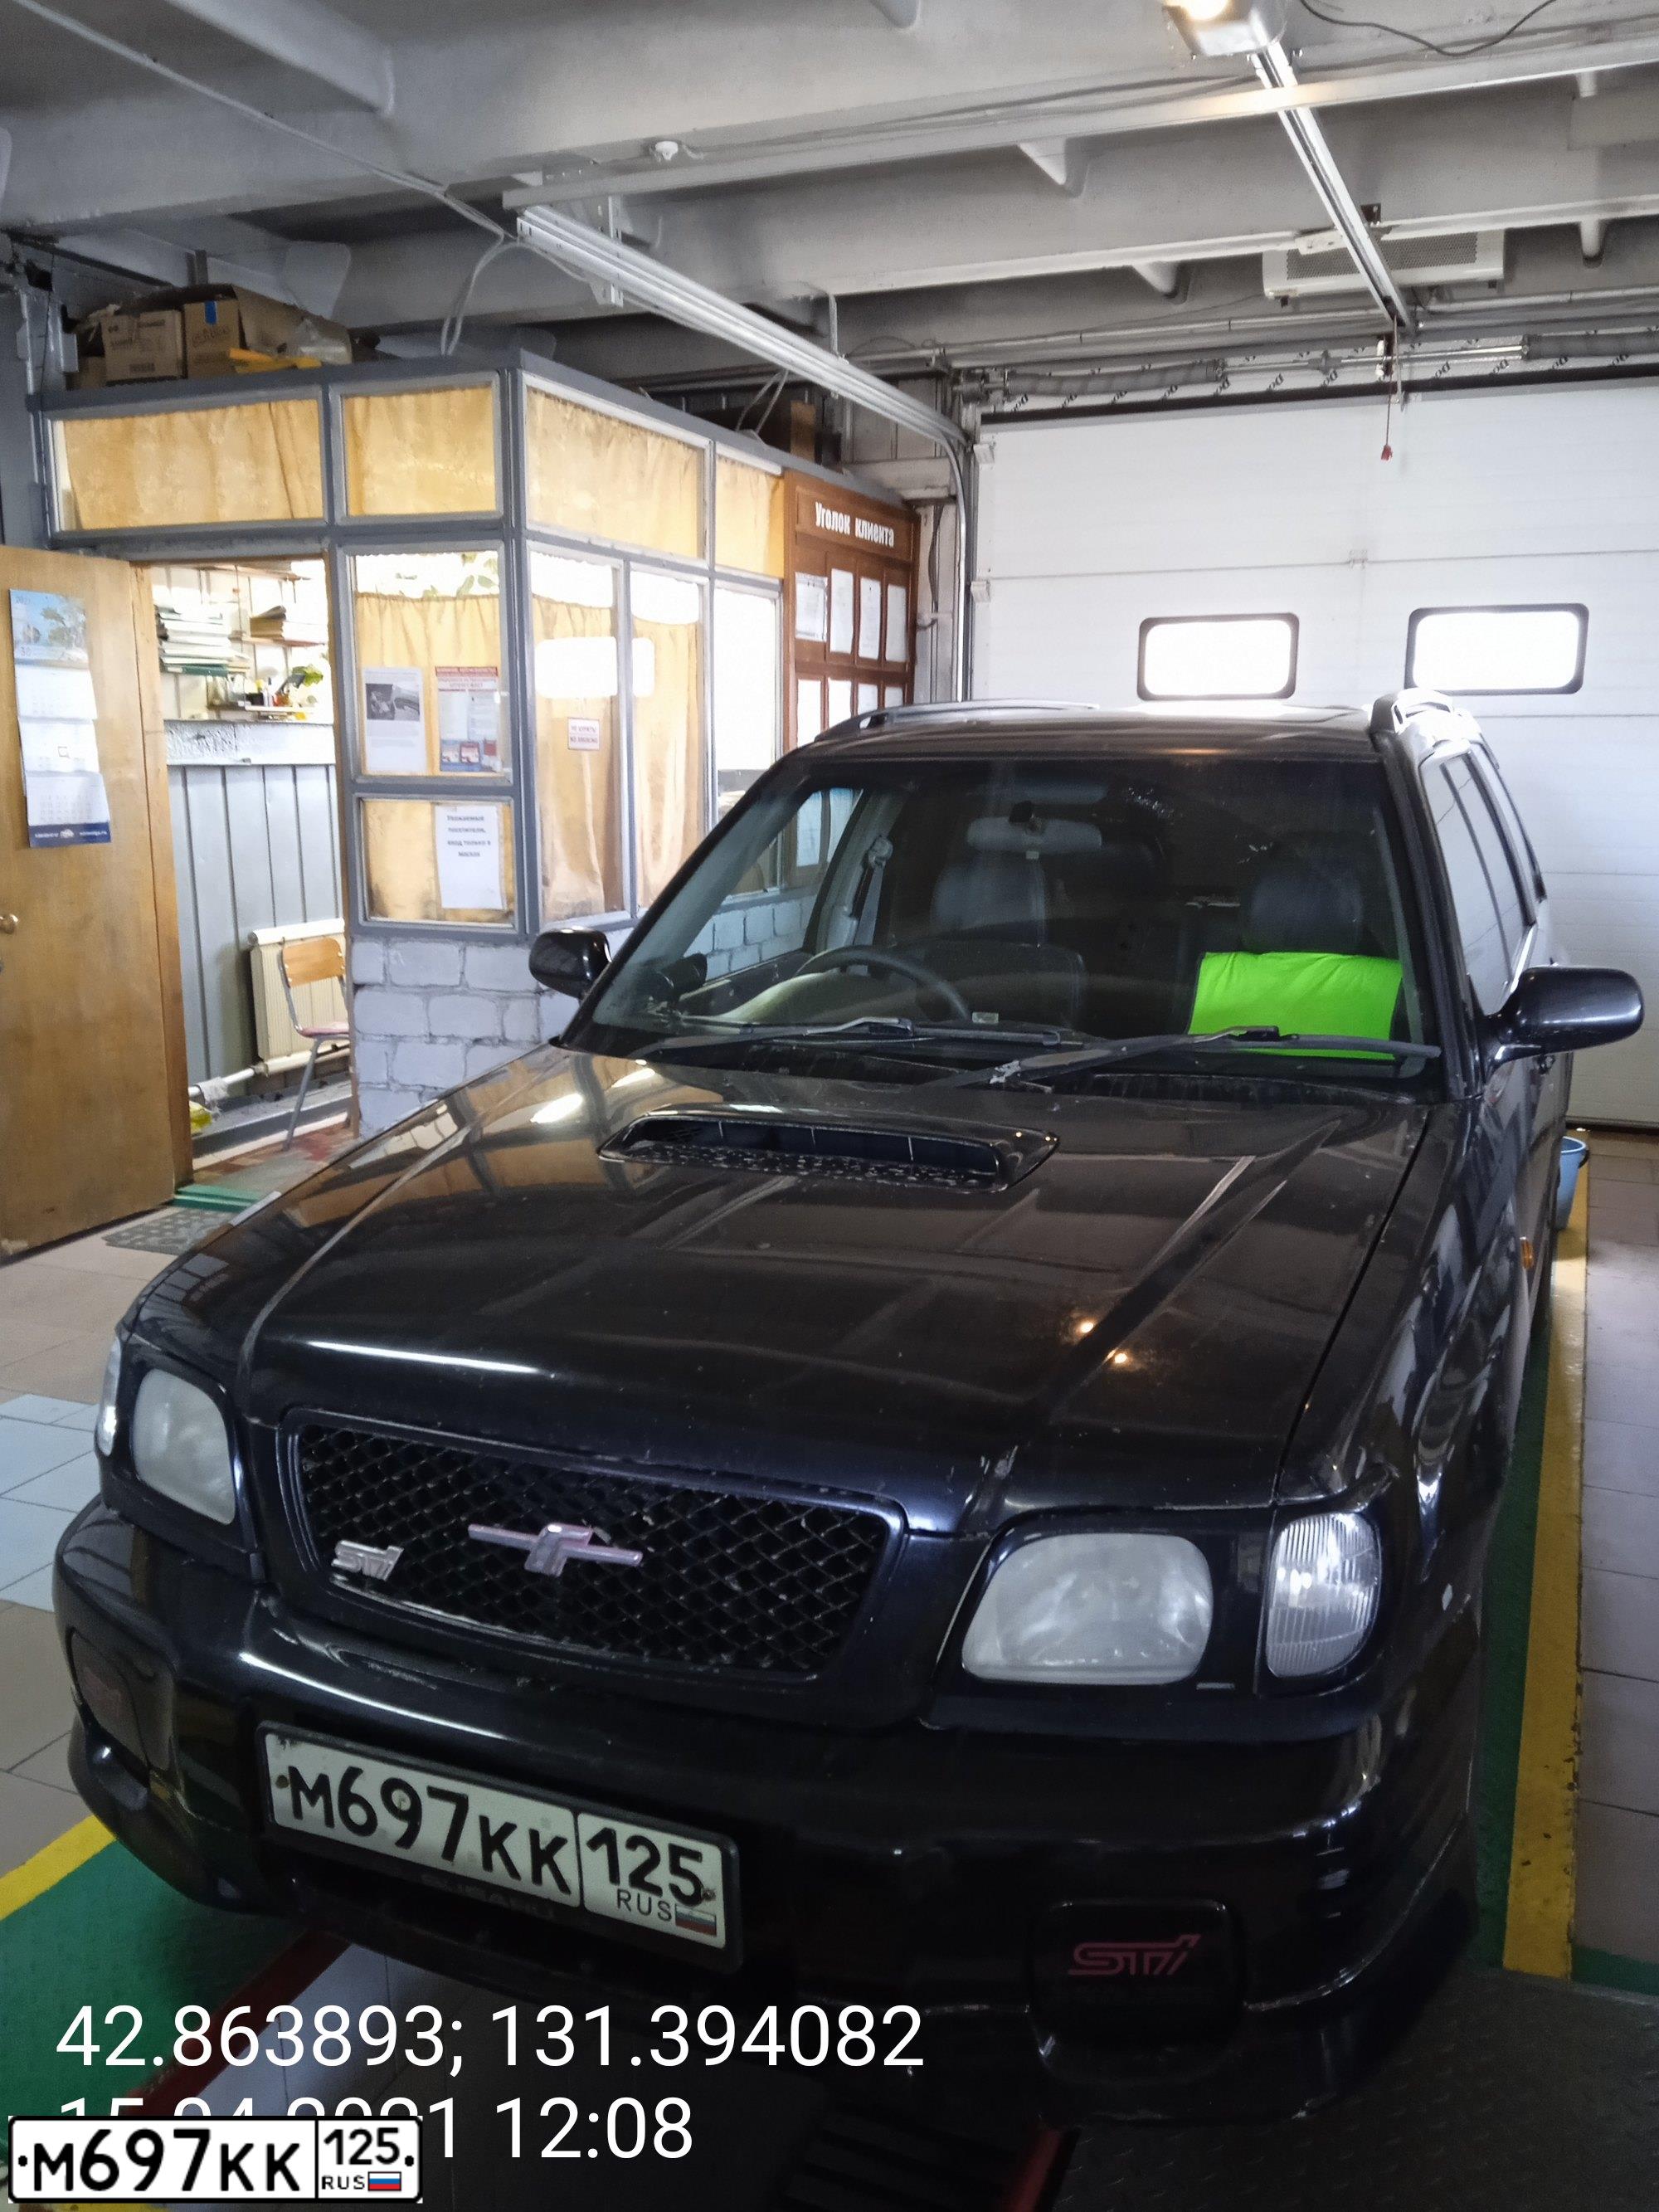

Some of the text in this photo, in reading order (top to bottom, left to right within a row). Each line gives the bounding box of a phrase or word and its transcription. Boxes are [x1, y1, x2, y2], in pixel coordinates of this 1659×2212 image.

[815, 501, 894, 548] Уголок клиента
[586, 1827, 706, 1907] 125
[616, 1888, 673, 1922] RUS
